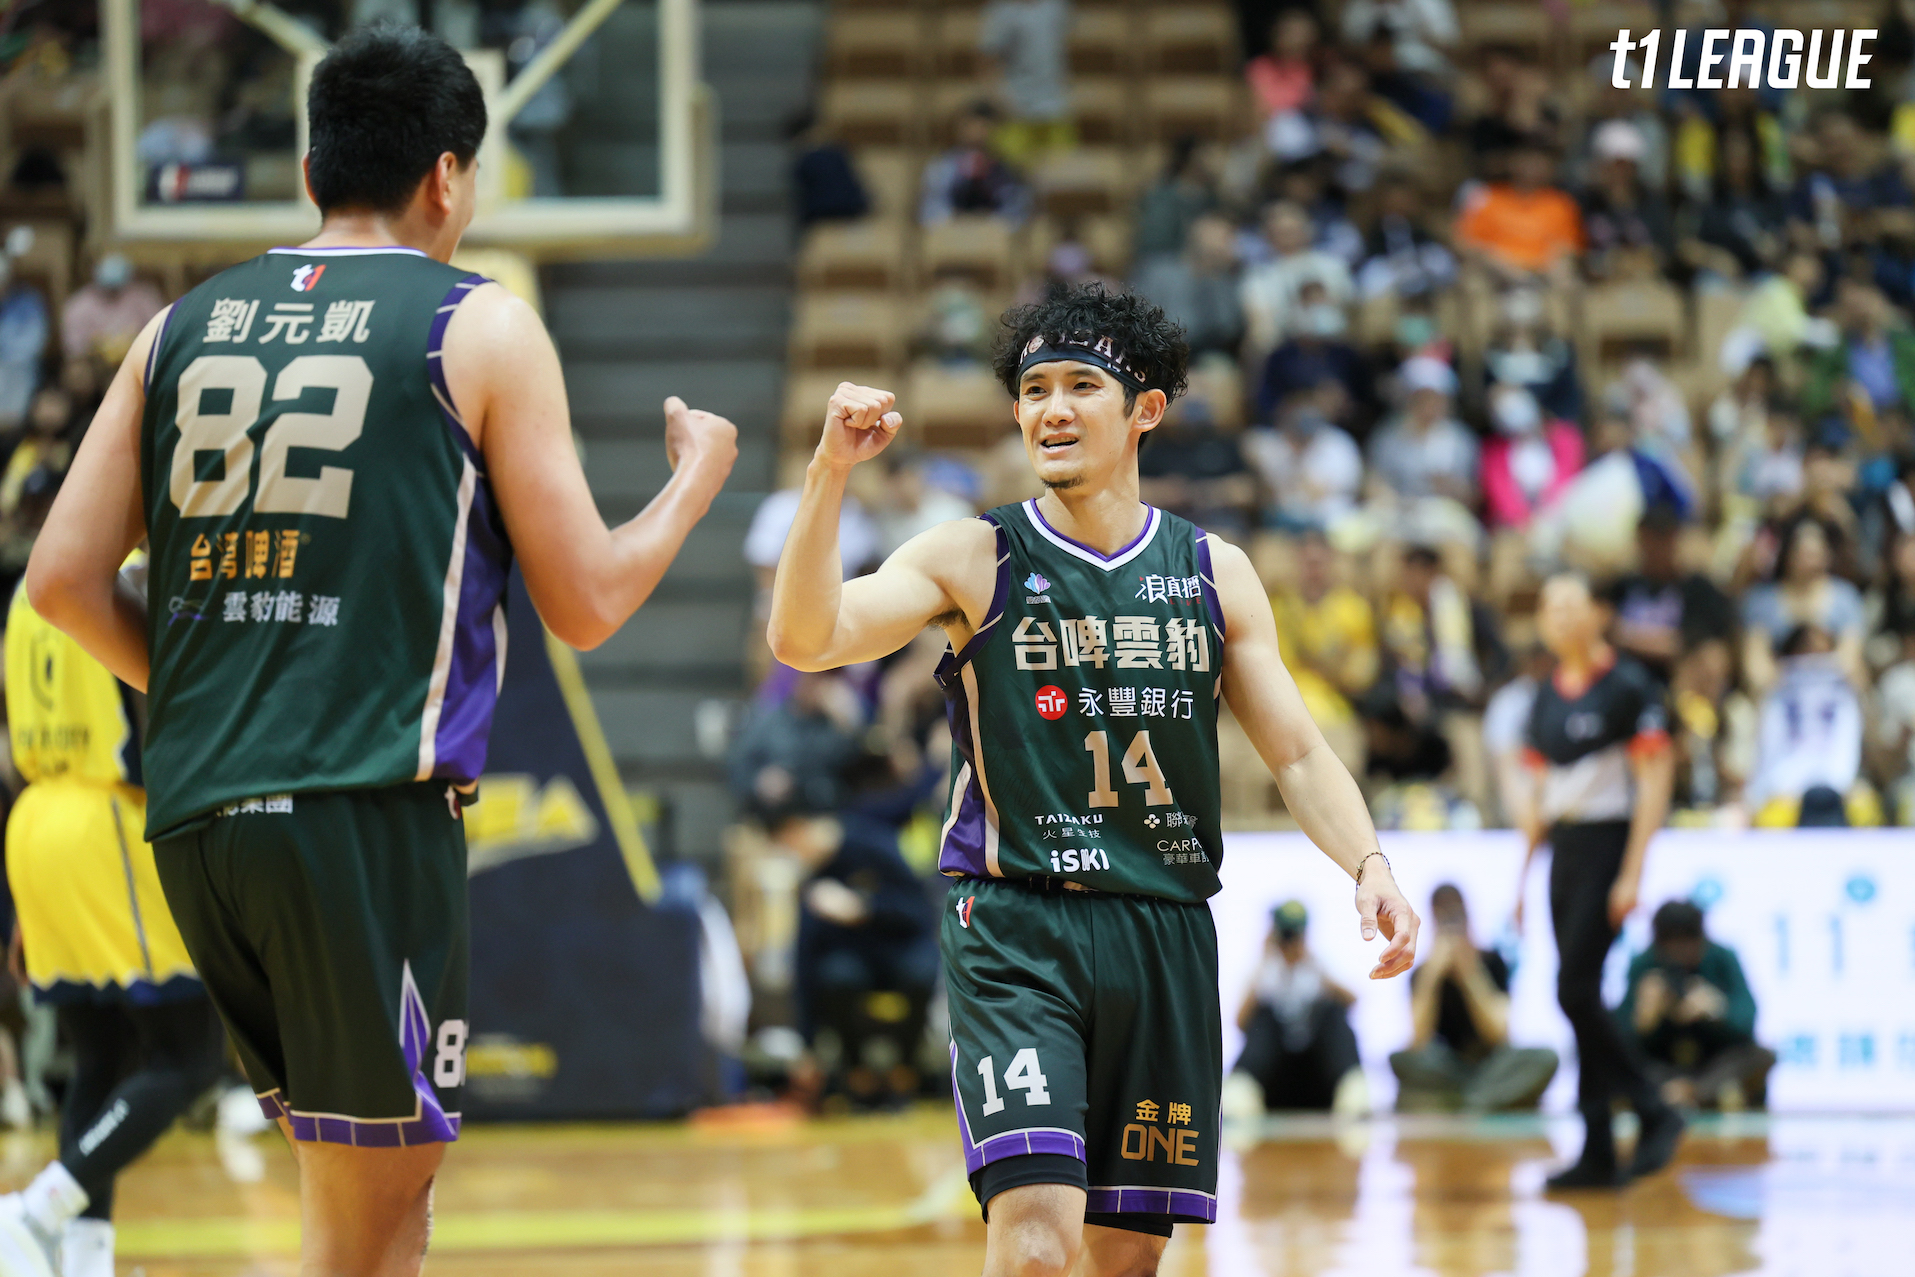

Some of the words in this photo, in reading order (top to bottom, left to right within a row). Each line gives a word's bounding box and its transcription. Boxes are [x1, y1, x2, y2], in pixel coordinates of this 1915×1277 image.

[203, 297, 375, 344] 劉元凱
[169, 355, 374, 519] 82
[223, 590, 341, 627] 雲豹能源
[1135, 574, 1201, 604] 浪直播
[1011, 615, 1210, 673] 台啤雲豹
[1078, 686, 1194, 720] 永豐銀行
[1084, 730, 1174, 808] 14
[433, 1018, 470, 1088] 8
[976, 1047, 1052, 1118] 14
[1135, 1098, 1192, 1126] 金牌
[1120, 1123, 1200, 1167] ONE
